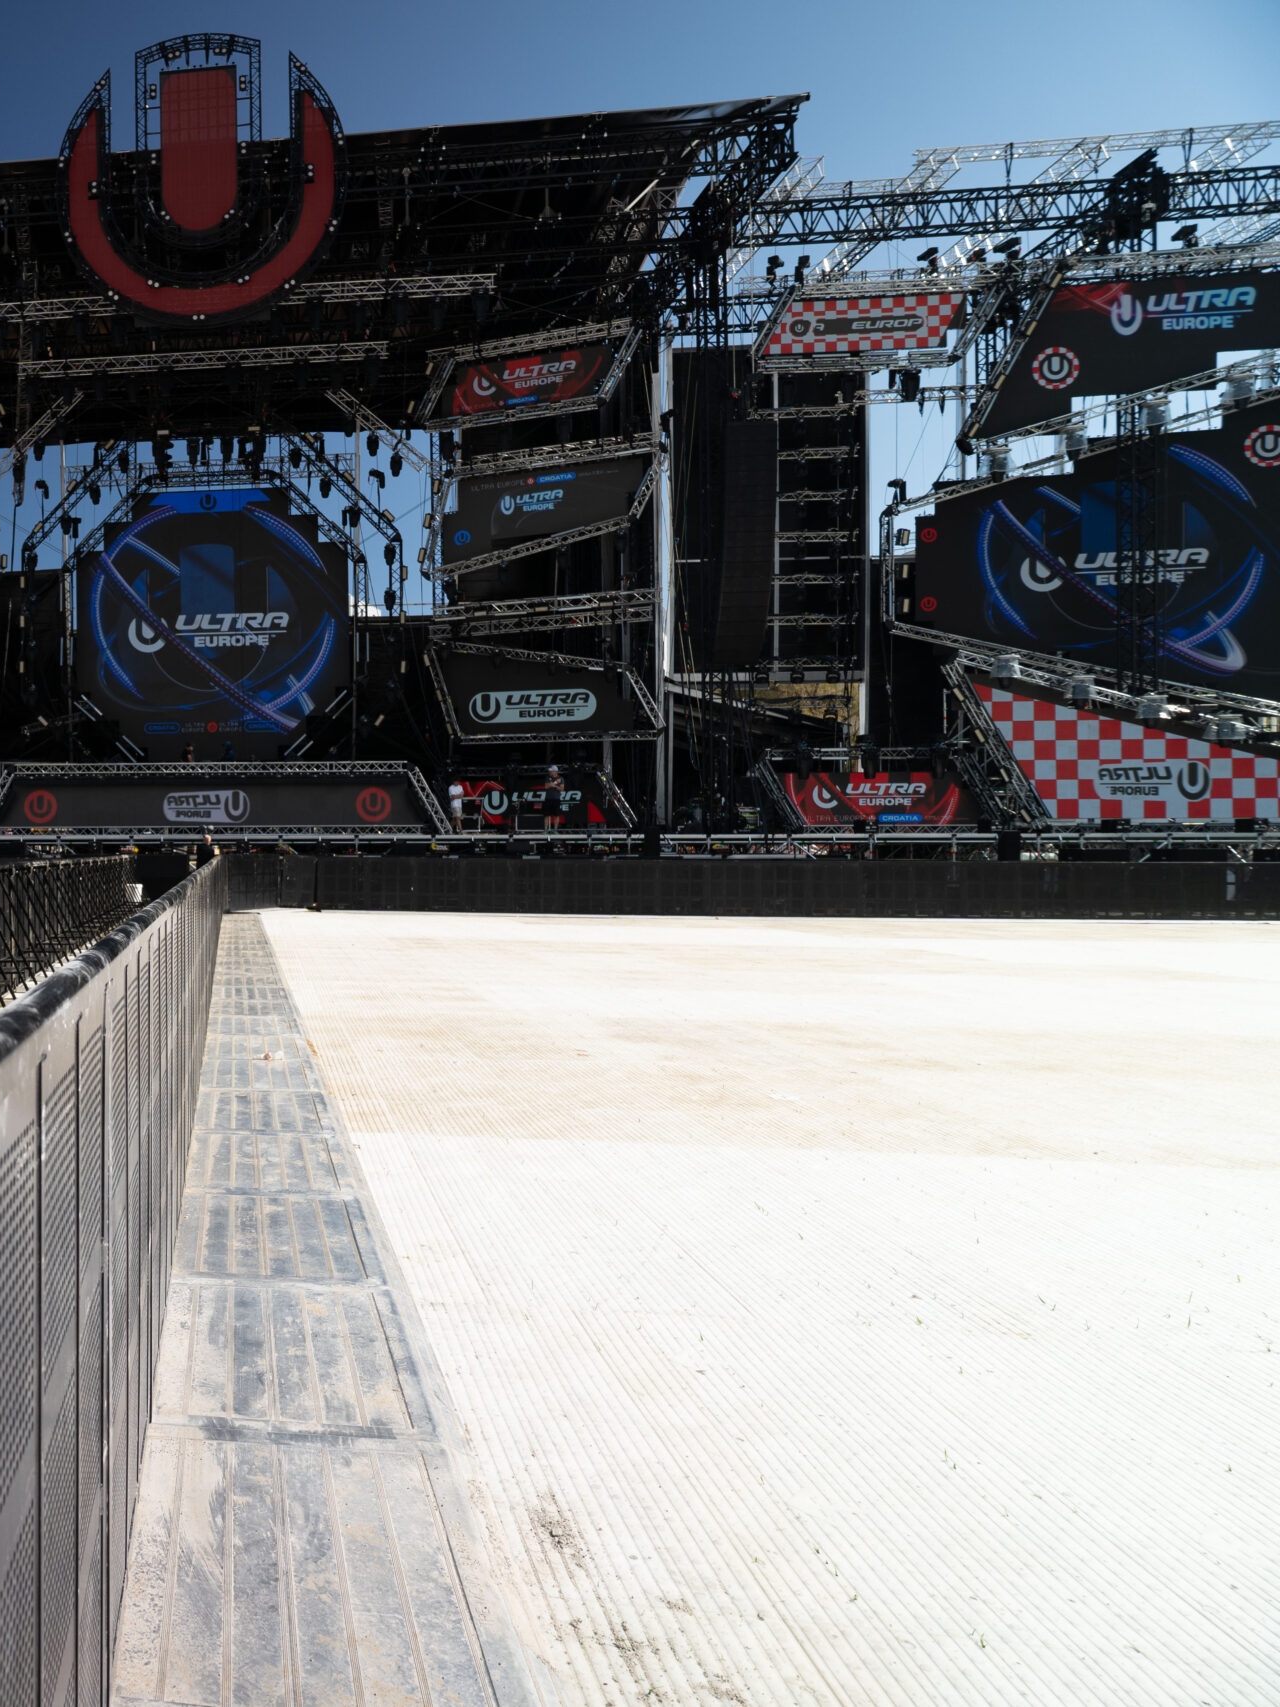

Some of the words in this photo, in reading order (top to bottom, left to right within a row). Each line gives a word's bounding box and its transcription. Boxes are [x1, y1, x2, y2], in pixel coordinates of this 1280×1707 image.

[1146, 286, 1257, 313] ULTRA
[851, 318, 923, 330] EUROP
[1162, 315, 1235, 330] EUROPE
[502, 360, 577, 380] ULTRA
[514, 375, 564, 389] EUROPE
[539, 473, 573, 482] CROATIA
[516, 489, 564, 504] ULTRA
[522, 502, 556, 512] EUROPE
[175, 611, 290, 632] ULTRA
[193, 634, 270, 648] EUROPE
[505, 692, 590, 706] ULTRA
[519, 709, 575, 718] EUROPE
[845, 782, 927, 796] ULTRA
[858, 797, 913, 806] EUROPE
